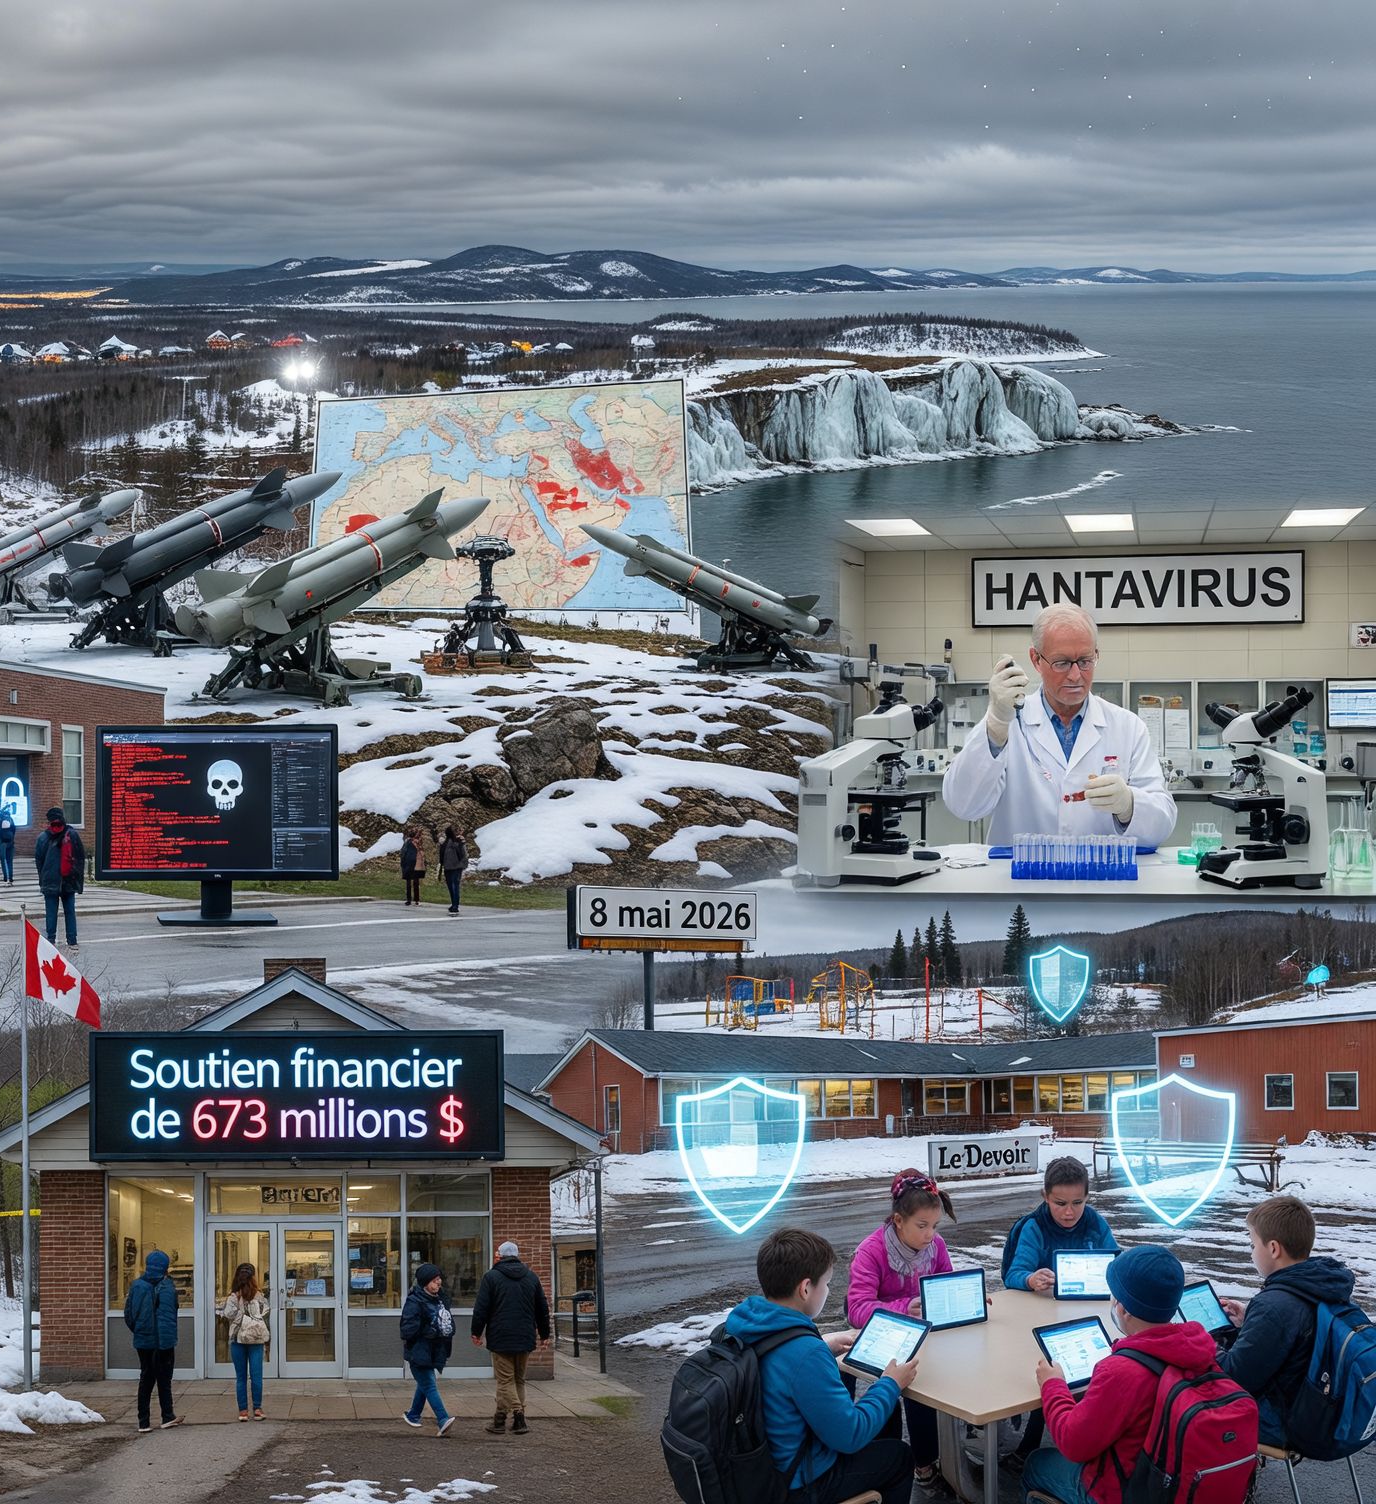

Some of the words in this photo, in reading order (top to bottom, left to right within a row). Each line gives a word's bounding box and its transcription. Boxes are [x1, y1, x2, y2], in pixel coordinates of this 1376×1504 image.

[985, 566, 1292, 611] HANTAVIRUS
[589, 897, 608, 927] 8
[618, 899, 671, 928] mai
[680, 900, 751, 930] 2026
[129, 1048, 280, 1089] Soutien
[290, 1046, 463, 1088] financier
[130, 1097, 180, 1139] de
[192, 1099, 267, 1139] 673
[280, 1098, 427, 1139] millions
[438, 1094, 465, 1143] $
[937, 1146, 962, 1169] Le
[964, 1140, 1031, 1168] Devoir
